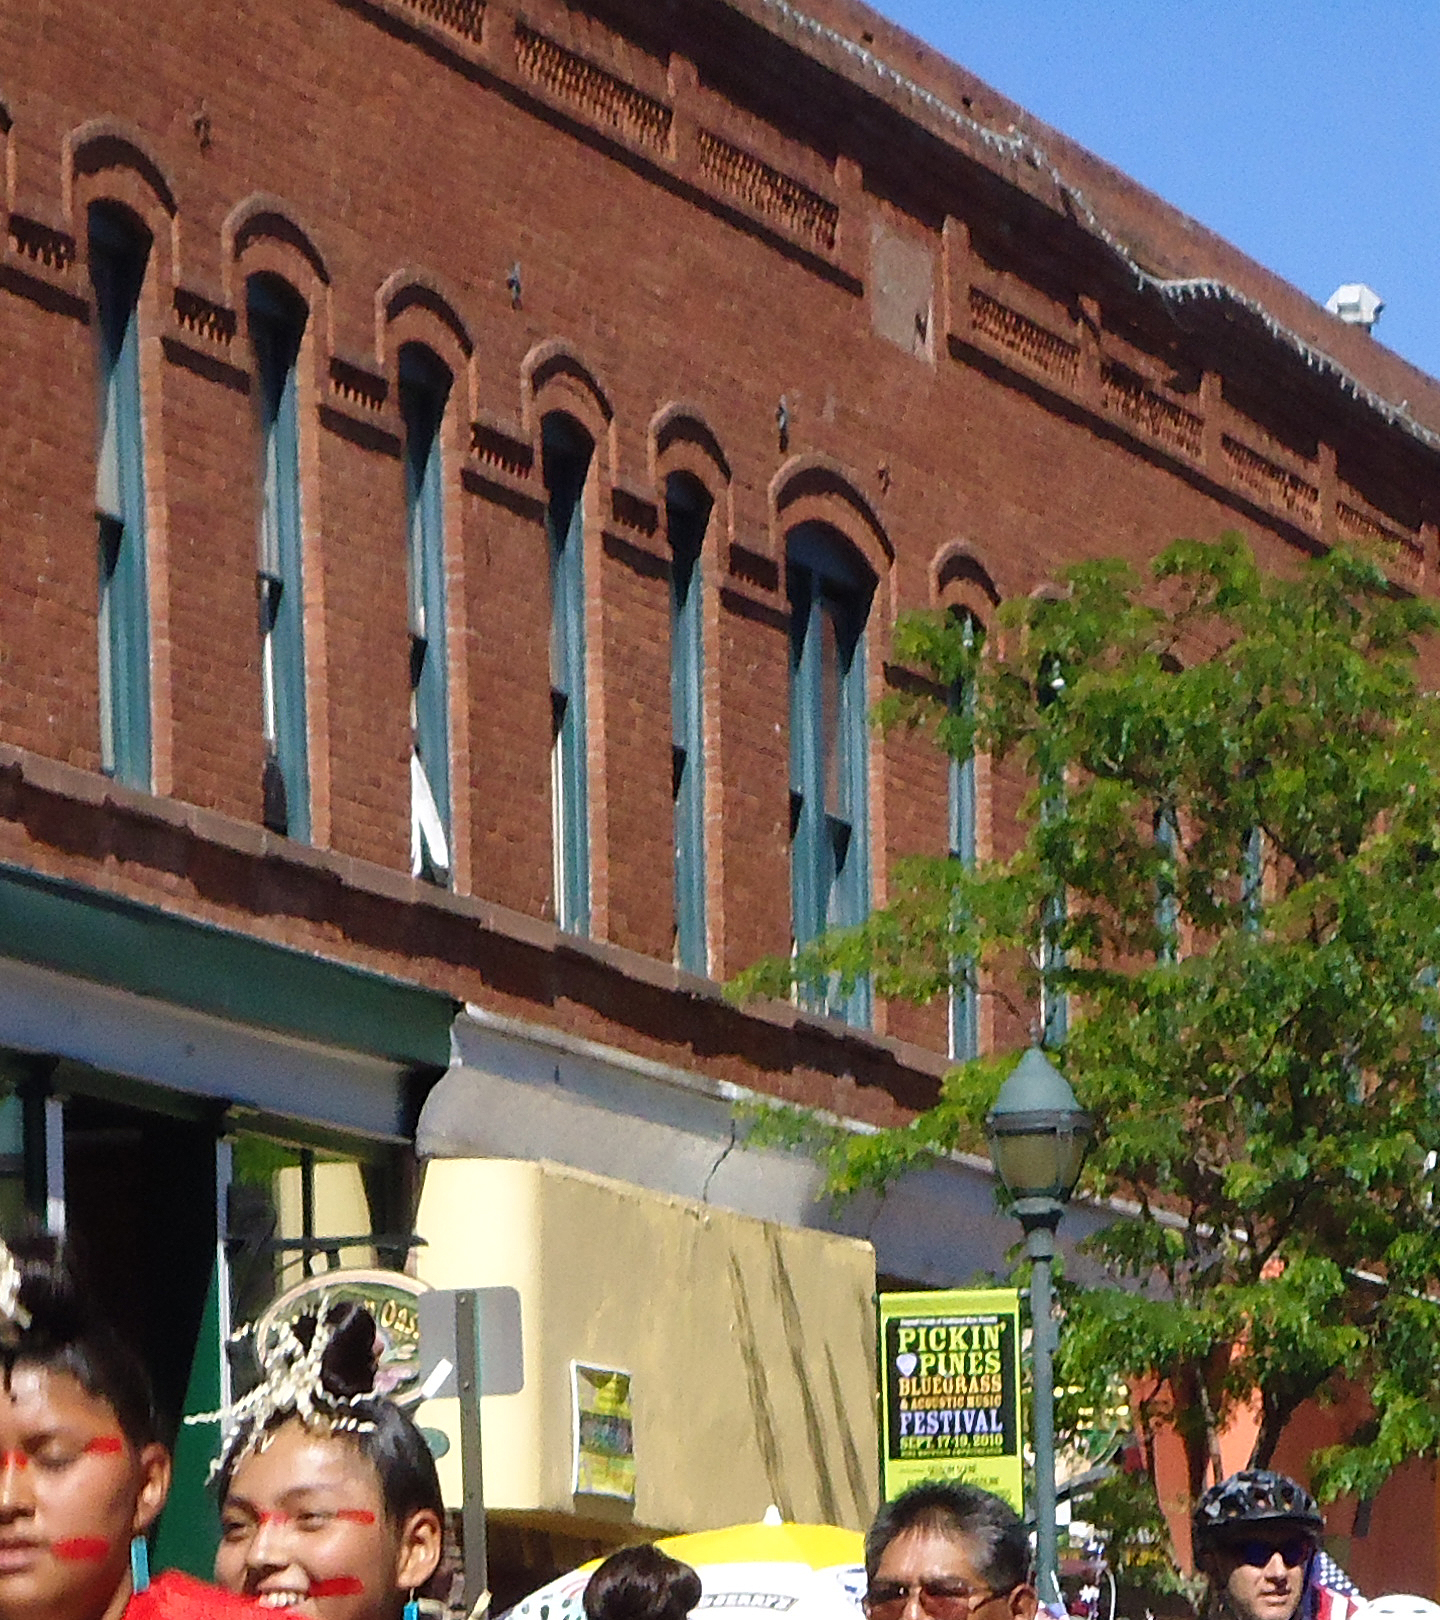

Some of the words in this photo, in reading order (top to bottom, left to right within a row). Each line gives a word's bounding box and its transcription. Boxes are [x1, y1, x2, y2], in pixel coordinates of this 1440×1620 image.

[898, 1321, 1007, 1353] PICKIN'
[920, 1350, 1001, 1377] PINES
[898, 1373, 1002, 1396] BLUEGRASS
[900, 1408, 1003, 1435] FESTIVAL
